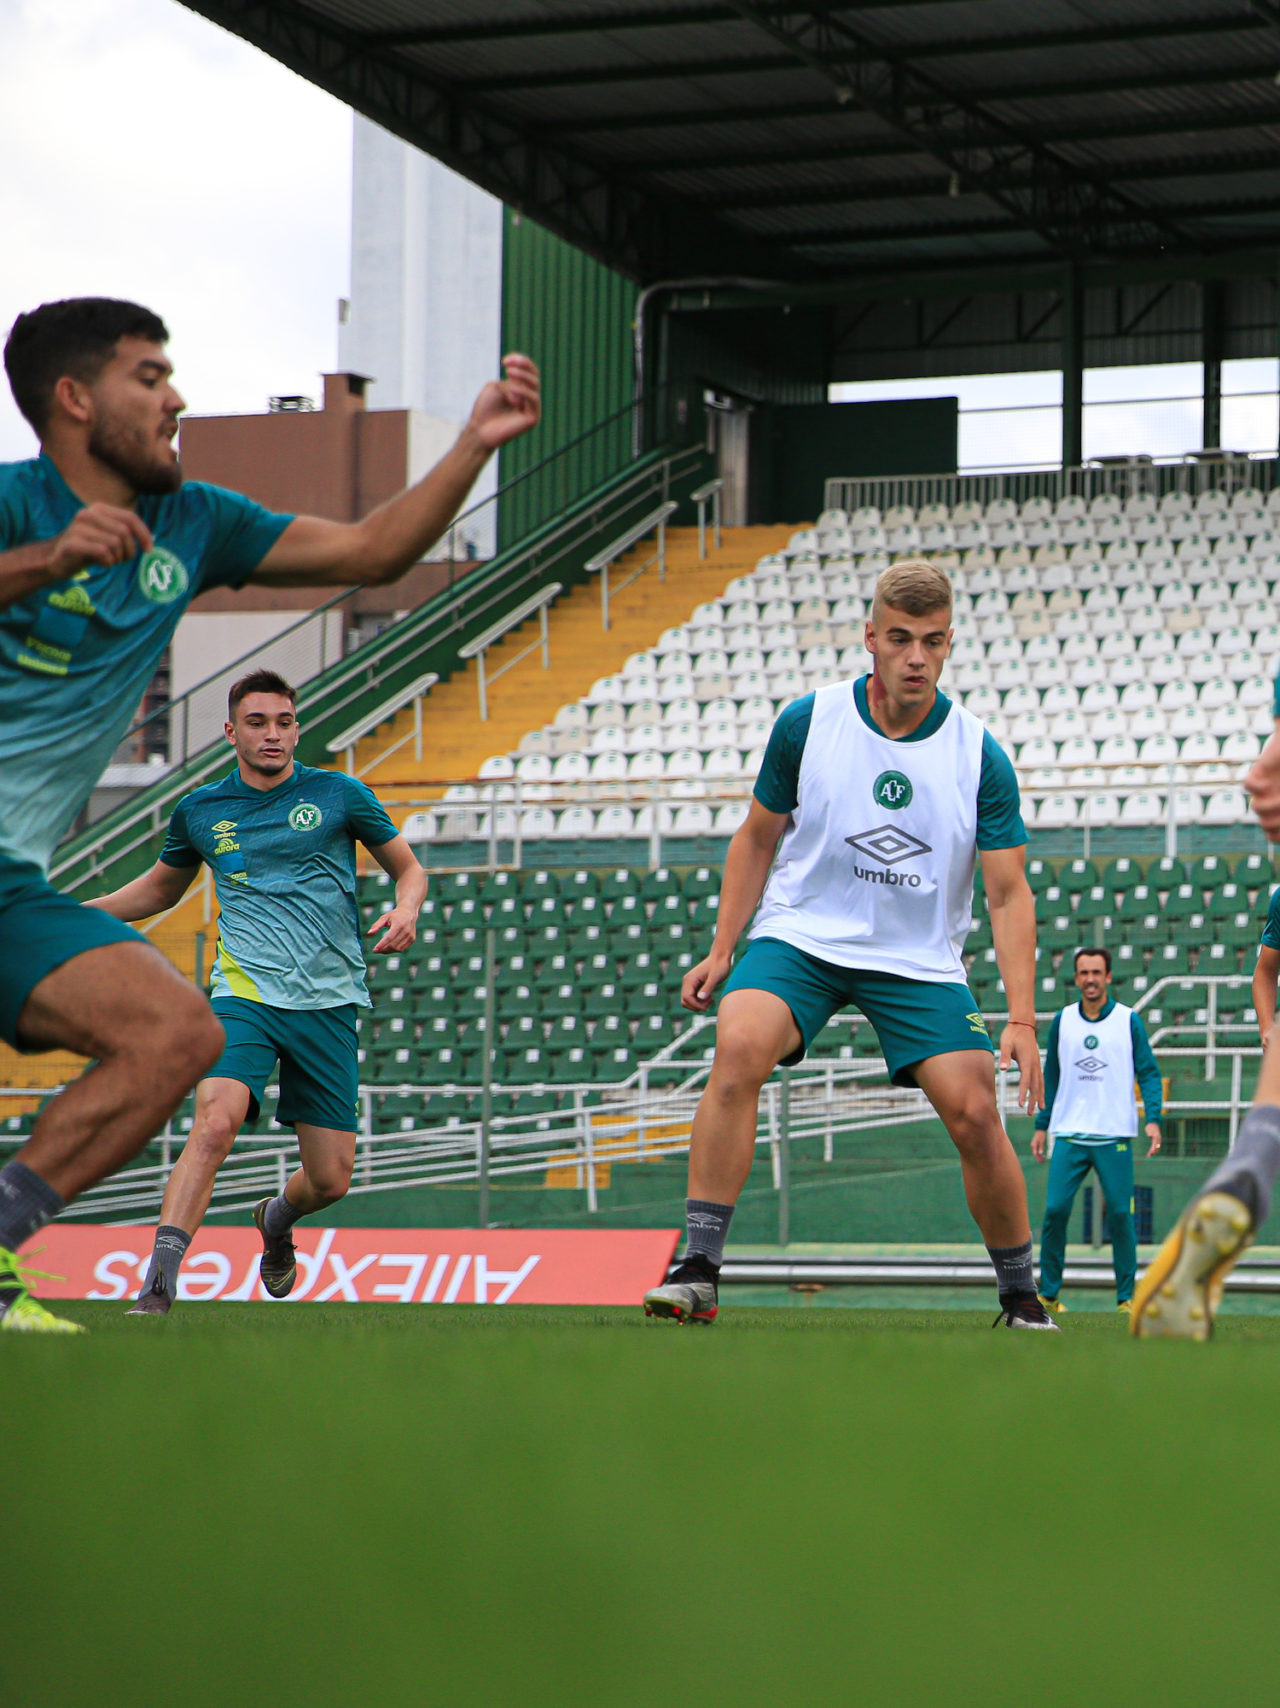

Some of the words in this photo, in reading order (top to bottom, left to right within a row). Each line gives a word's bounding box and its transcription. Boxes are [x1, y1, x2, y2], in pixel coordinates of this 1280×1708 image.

[214, 831, 237, 840] umbro
[214, 843, 240, 855] aurora
[853, 865, 921, 888] umbro
[688, 1221, 720, 1232] mbro
